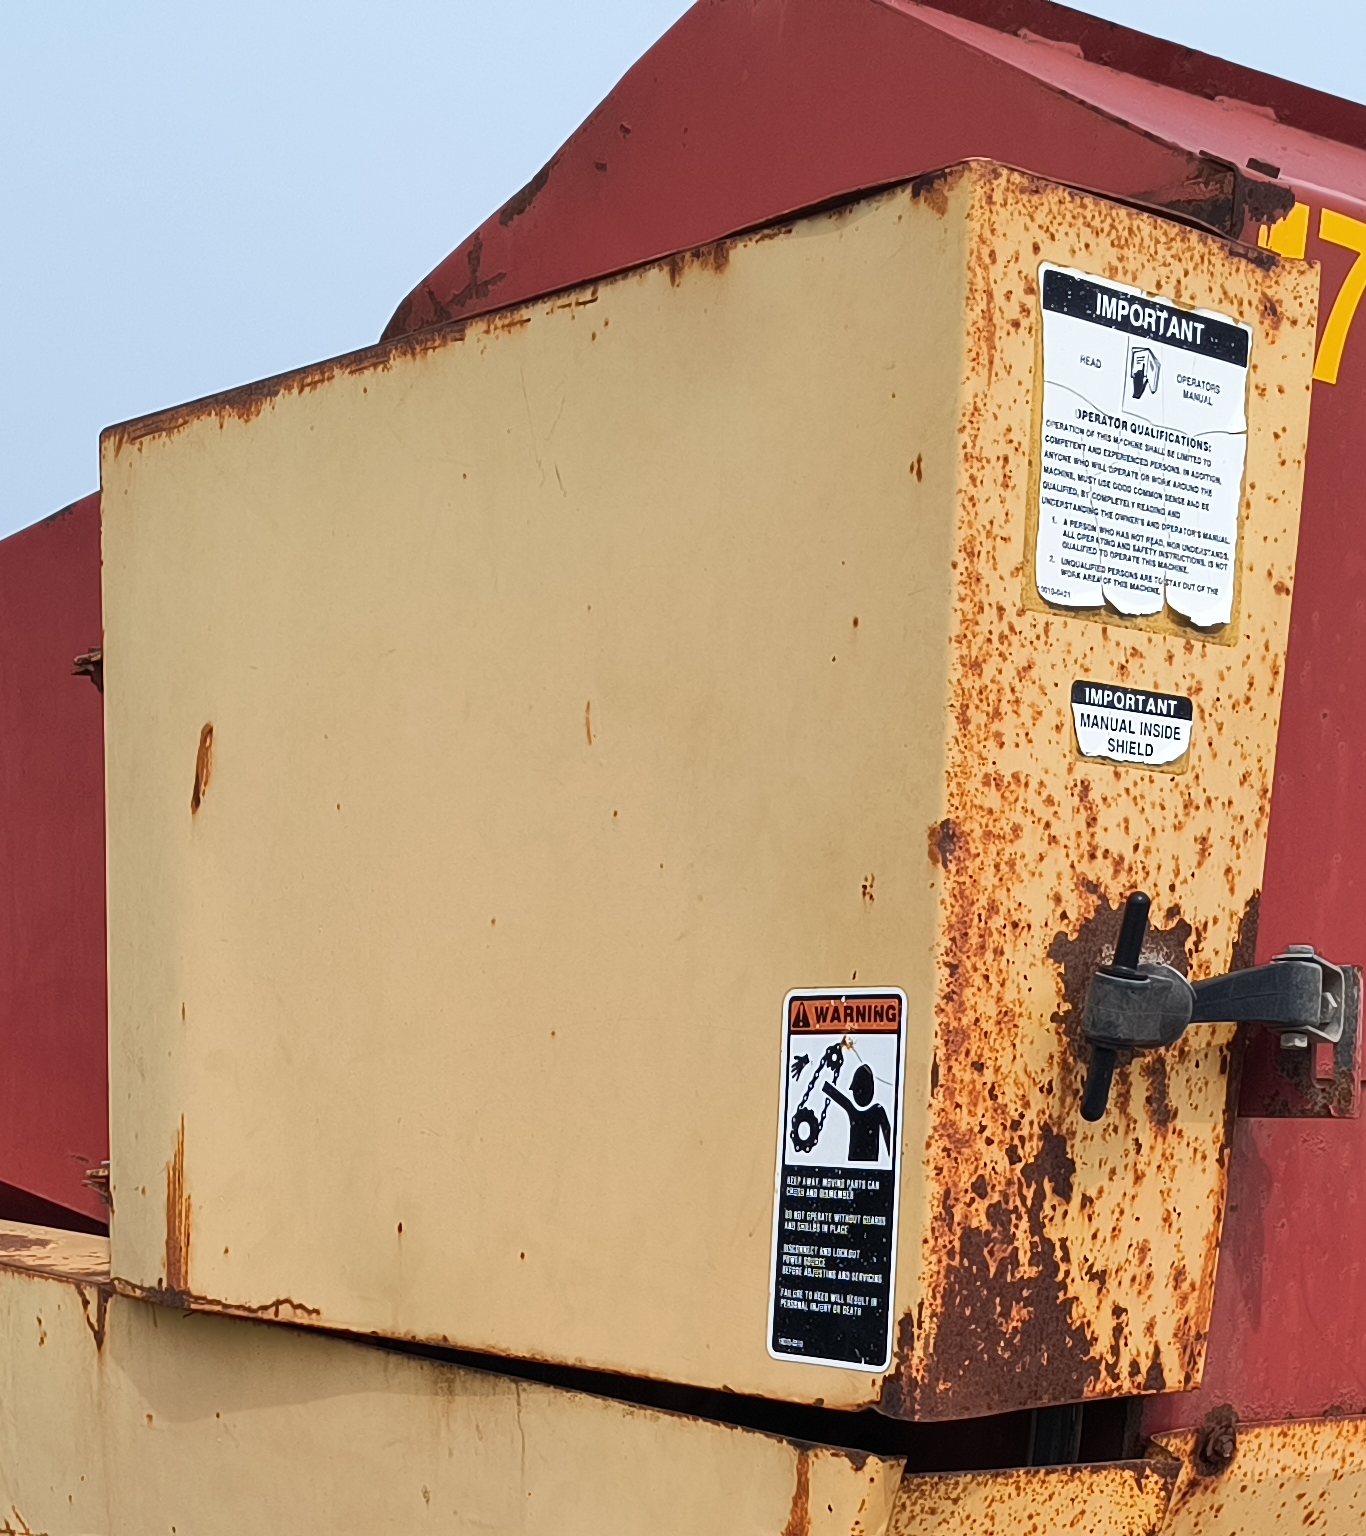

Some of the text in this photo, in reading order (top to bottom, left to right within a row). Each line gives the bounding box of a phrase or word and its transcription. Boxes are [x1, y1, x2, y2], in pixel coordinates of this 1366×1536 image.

[1095, 293, 1205, 345] IMPORTANT
[1080, 356, 1102, 369] READ
[1176, 374, 1220, 394] OPERATORS
[1183, 389, 1213, 406] MANUAL
[1045, 434, 1086, 452] COMPETENT
[1087, 445, 1101, 455] AND
[1046, 419, 1085, 435] OPERATION
[1145, 444, 1165, 456] SHALL
[1167, 449, 1175, 458] BE
[1176, 452, 1202, 465] LIMITED
[1203, 458, 1212, 467] TO
[1130, 422, 1211, 453] QUALIFICATIONS:
[1044, 450, 1212, 497] ANYONE WHO WILL OPERATE OR WORK AROUND THE
[1077, 473, 1097, 485] MUST
[1098, 479, 1111, 489] USE
[1112, 482, 1132, 493] GOOD
[1133, 486, 1163, 500] COMMON
[1165, 494, 1185, 505] SENSE
[1187, 499, 1200, 509] AND
[1201, 502, 1209, 511] BE
[1081, 489, 1090, 498] BY
[1137, 502, 1166, 516] READING
[1167, 510, 1181, 519] AND
[1069, 520, 1097, 532] PERSON
[1099, 526, 1115, 536] WHO
[1116, 530, 1129, 539] HAS
[1131, 533, 1144, 542] NOT
[1101, 509, 1113, 519] THE
[1146, 520, 1159, 530] AND
[1062, 530, 1075, 540] ALL
[1117, 541, 1131, 551] AND
[1215, 562, 1228, 571] NOT
[1062, 541, 1097, 555] QUALIFIED
[1099, 548, 1108, 557] TO
[1110, 551, 1140, 564] OPERATE
[1142, 557, 1156, 568] THIS
[1061, 569, 1081, 579] WORK
[1083, 573, 1101, 583] AREA
[1103, 577, 1112, 585] OF
[1113, 579, 1128, 589] THIS
[1107, 567, 1138, 580] PERSONS
[1139, 574, 1153, 583] ARE
[1164, 577, 1181, 588] STAY
[1182, 582, 1195, 591] OUT
[1207, 586, 1219, 596] THE
[1085, 688, 1177, 715] IMPORTANT
[1080, 713, 1181, 740] MANUAL INSIDE
[1108, 738, 1153, 756] SHIELD
[814, 1004, 897, 1024] WARNING
